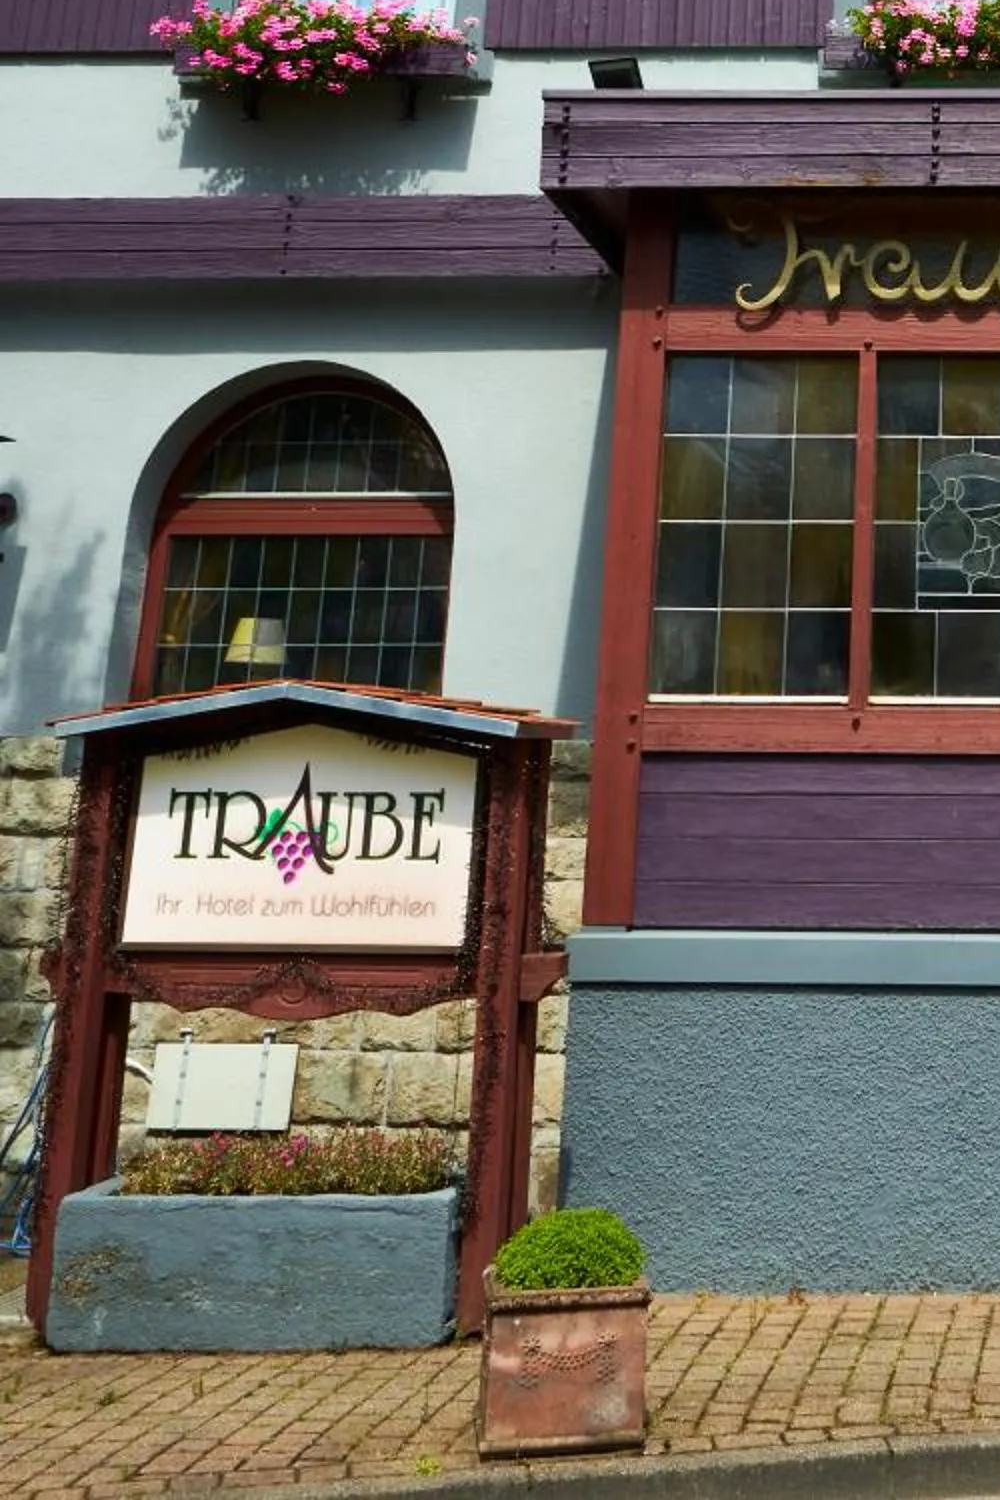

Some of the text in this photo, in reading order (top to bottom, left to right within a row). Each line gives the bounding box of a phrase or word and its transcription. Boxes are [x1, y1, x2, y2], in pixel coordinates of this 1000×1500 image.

[169, 762, 445, 874] TRAUBE
[196, 894, 255, 917] Hotel
[260, 898, 304, 917] zum
[310, 894, 436, 918] Wohlfühlen
